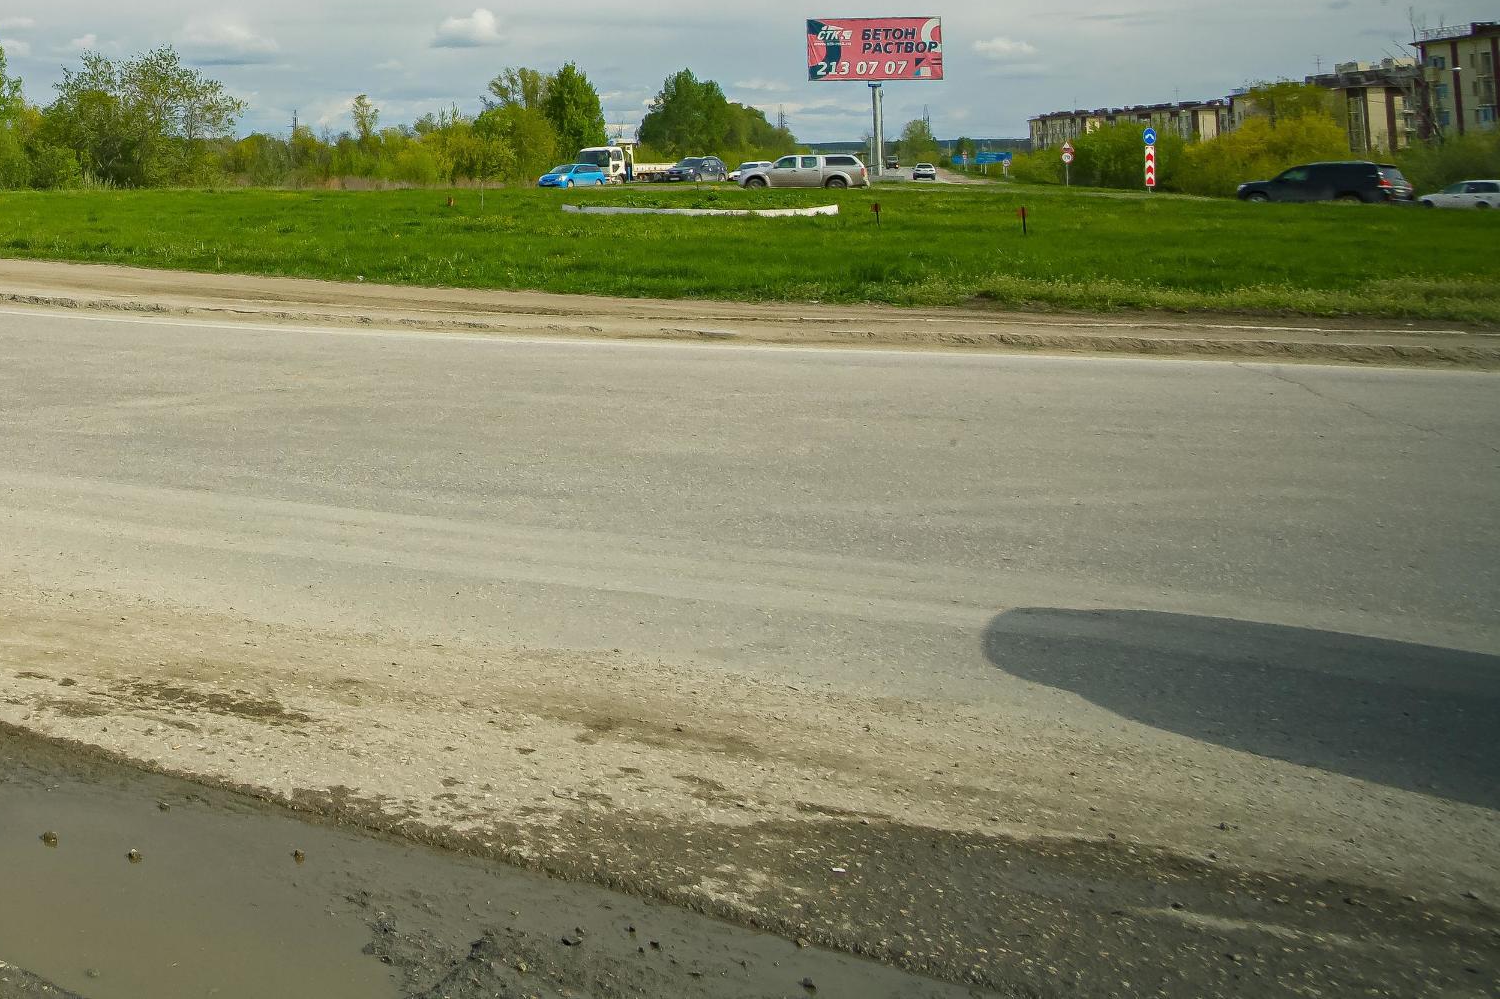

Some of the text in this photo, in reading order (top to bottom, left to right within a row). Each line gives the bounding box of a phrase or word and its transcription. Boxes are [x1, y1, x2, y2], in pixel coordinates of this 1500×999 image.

[861, 28, 916, 41] БЕТОН
[861, 41, 939, 54] РАСТВОР
[816, 60, 908, 76] 213 07 07
